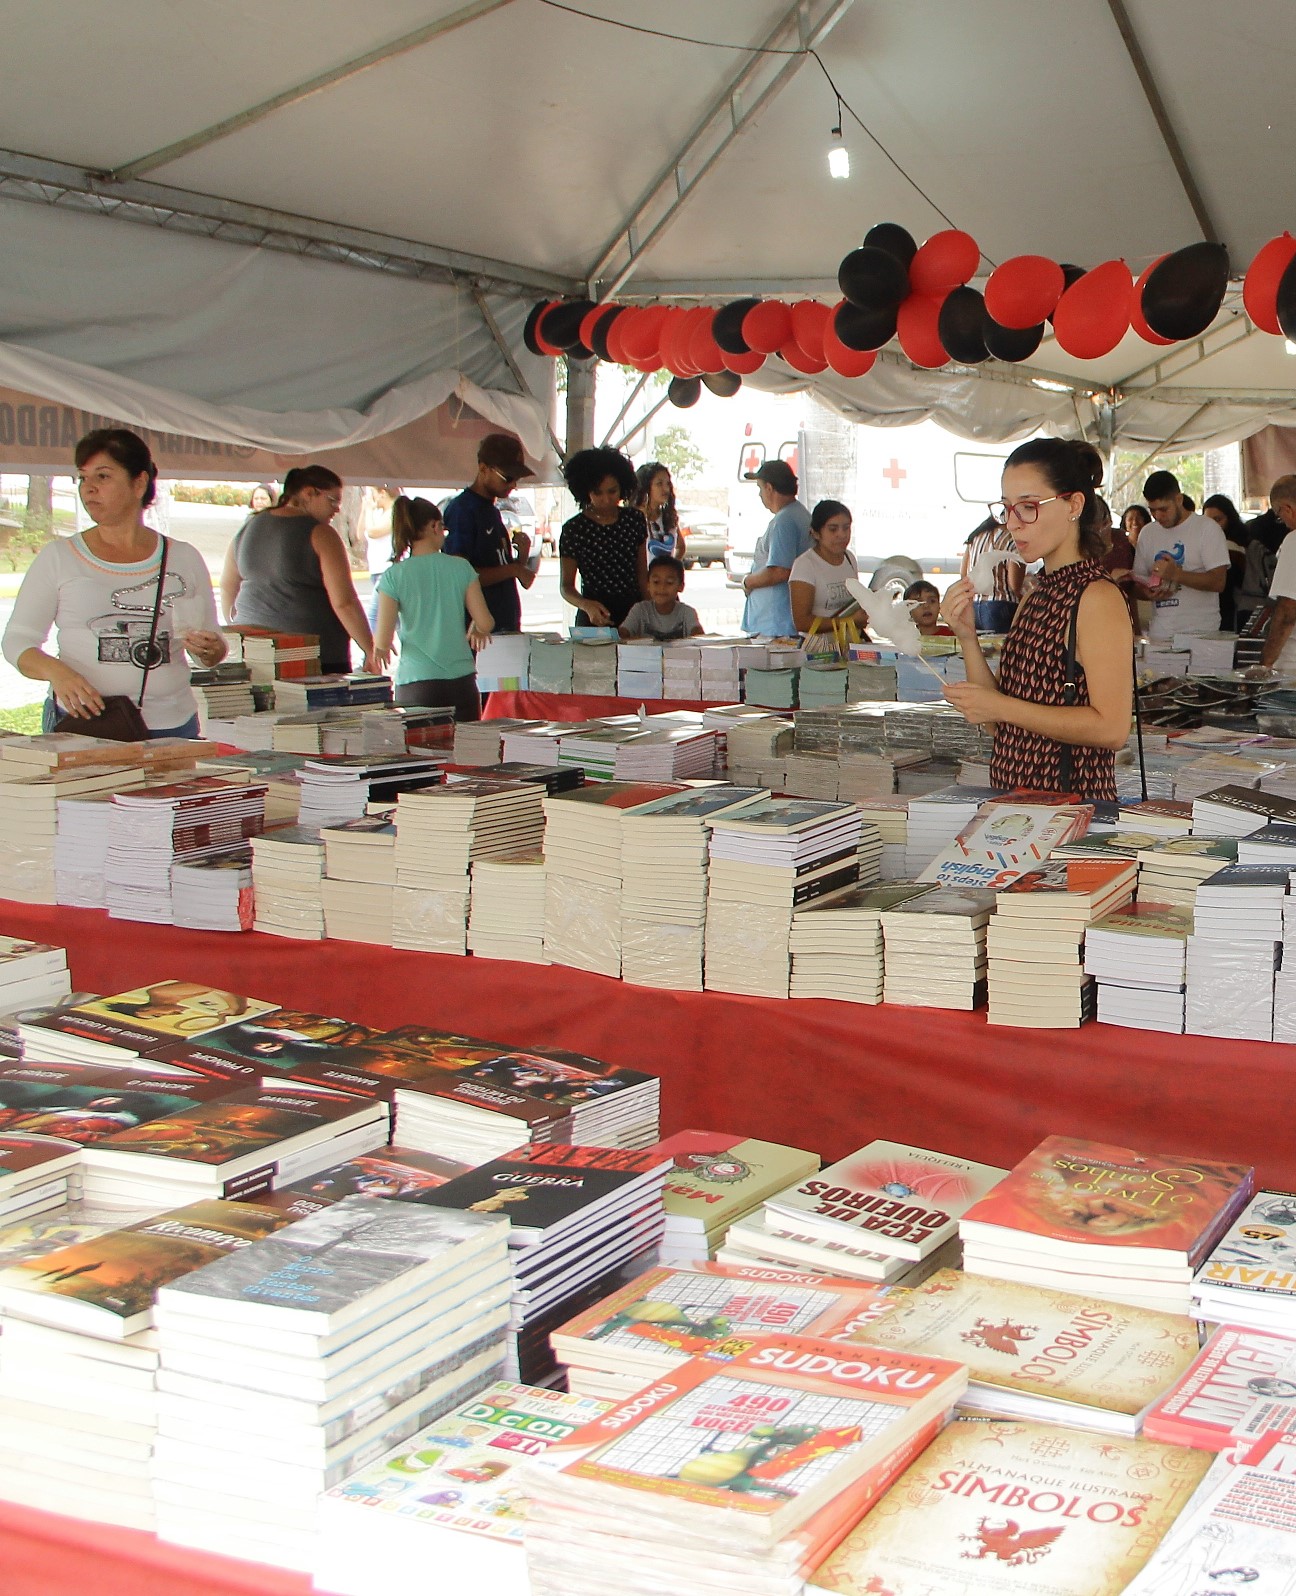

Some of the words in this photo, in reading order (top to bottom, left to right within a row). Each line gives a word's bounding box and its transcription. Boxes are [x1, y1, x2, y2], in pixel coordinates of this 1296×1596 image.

[941, 861, 999, 879] English
[987, 871, 1021, 888] 3
[492, 1172, 585, 1188] GUERRA
[797, 1180, 952, 1229] QUEIROS
[145, 1218, 253, 1249] Recomeço
[284, 1262, 335, 1275] Morro
[736, 1267, 823, 1286] SUDOKU
[243, 1284, 321, 1303] Uivantes
[258, 1278, 315, 1292] Ventos
[761, 1300, 801, 1324] 490
[779, 1341, 939, 1371] ALMANAQUE
[1010, 1303, 1114, 1387] SÍMBOLOS
[749, 1347, 937, 1390] SUDOKU
[599, 1382, 678, 1430] SUDOKU
[727, 1394, 792, 1414] 490
[462, 1403, 576, 1438] Dicion
[690, 1415, 751, 1433] VOCÊ!
[955, 1458, 1065, 1487] ALMANAQUE
[1068, 1480, 1155, 1501] ILUSTRADO
[931, 1467, 1149, 1528] SÍMBOLOS
